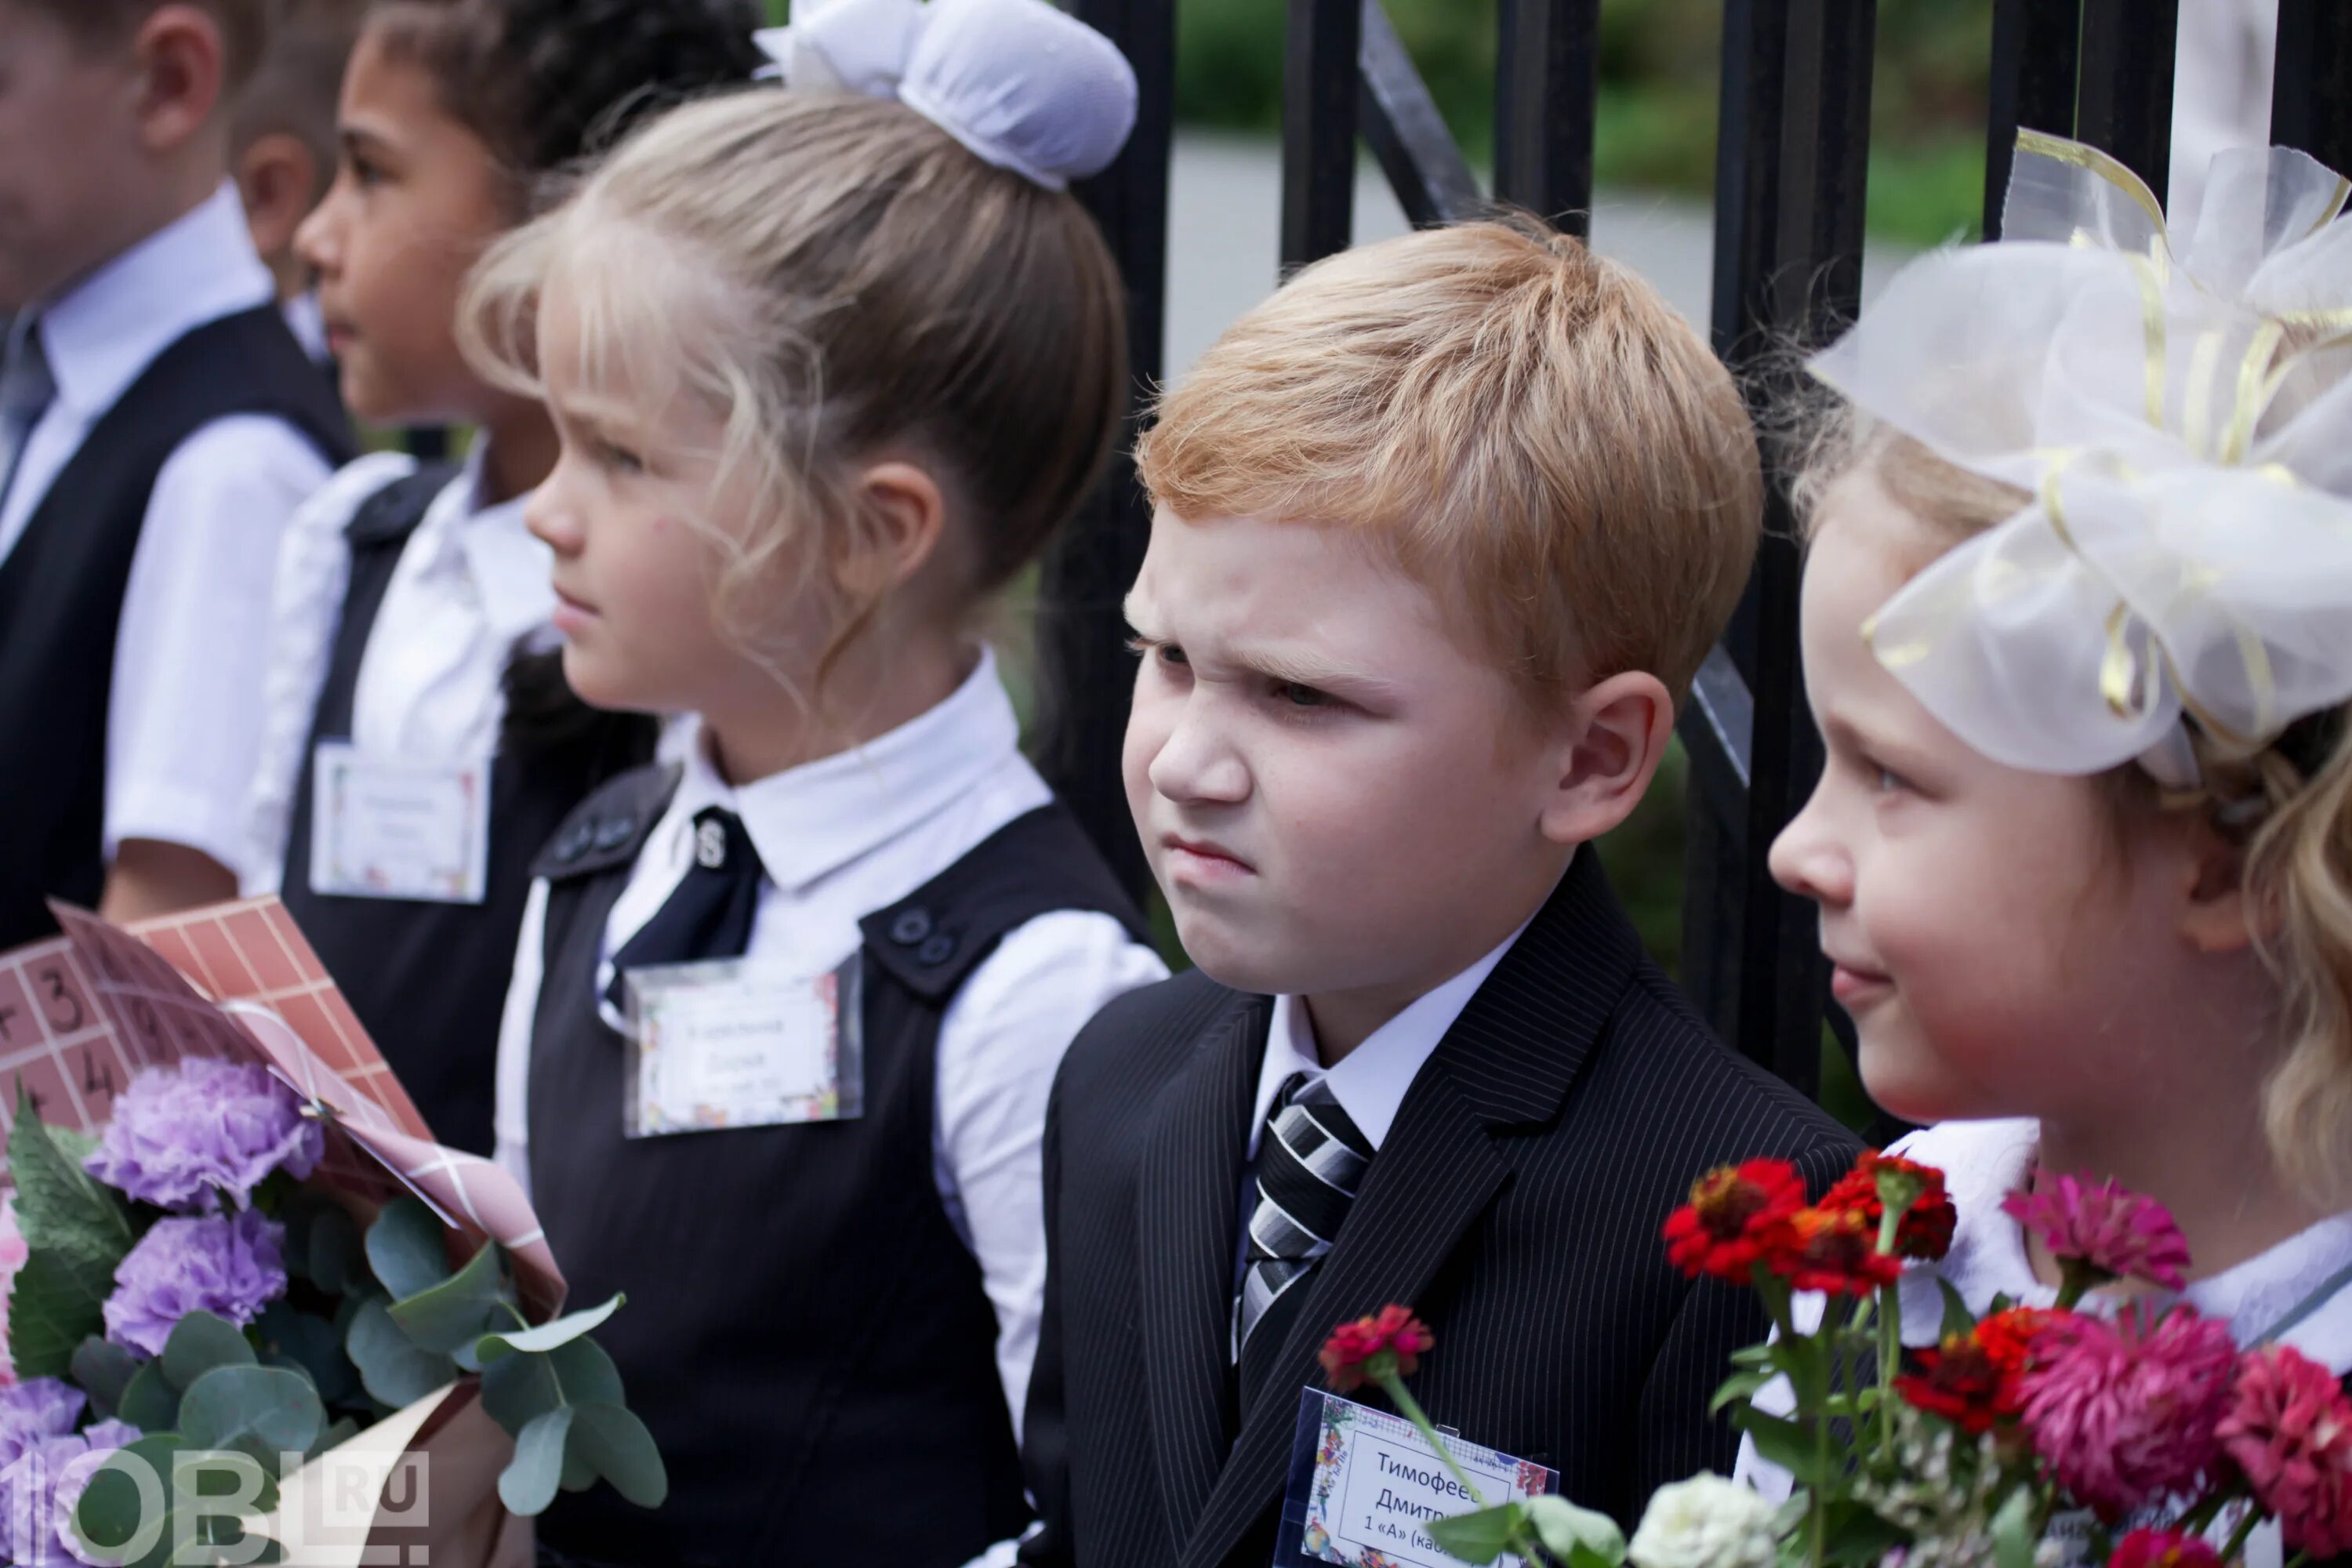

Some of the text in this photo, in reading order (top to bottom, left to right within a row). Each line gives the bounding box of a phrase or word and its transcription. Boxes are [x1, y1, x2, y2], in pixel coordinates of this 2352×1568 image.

[41, 967, 82, 1033] 3
[1364, 1515, 1373, 1530] 1
[1375, 1488, 1457, 1524] Дмитр
